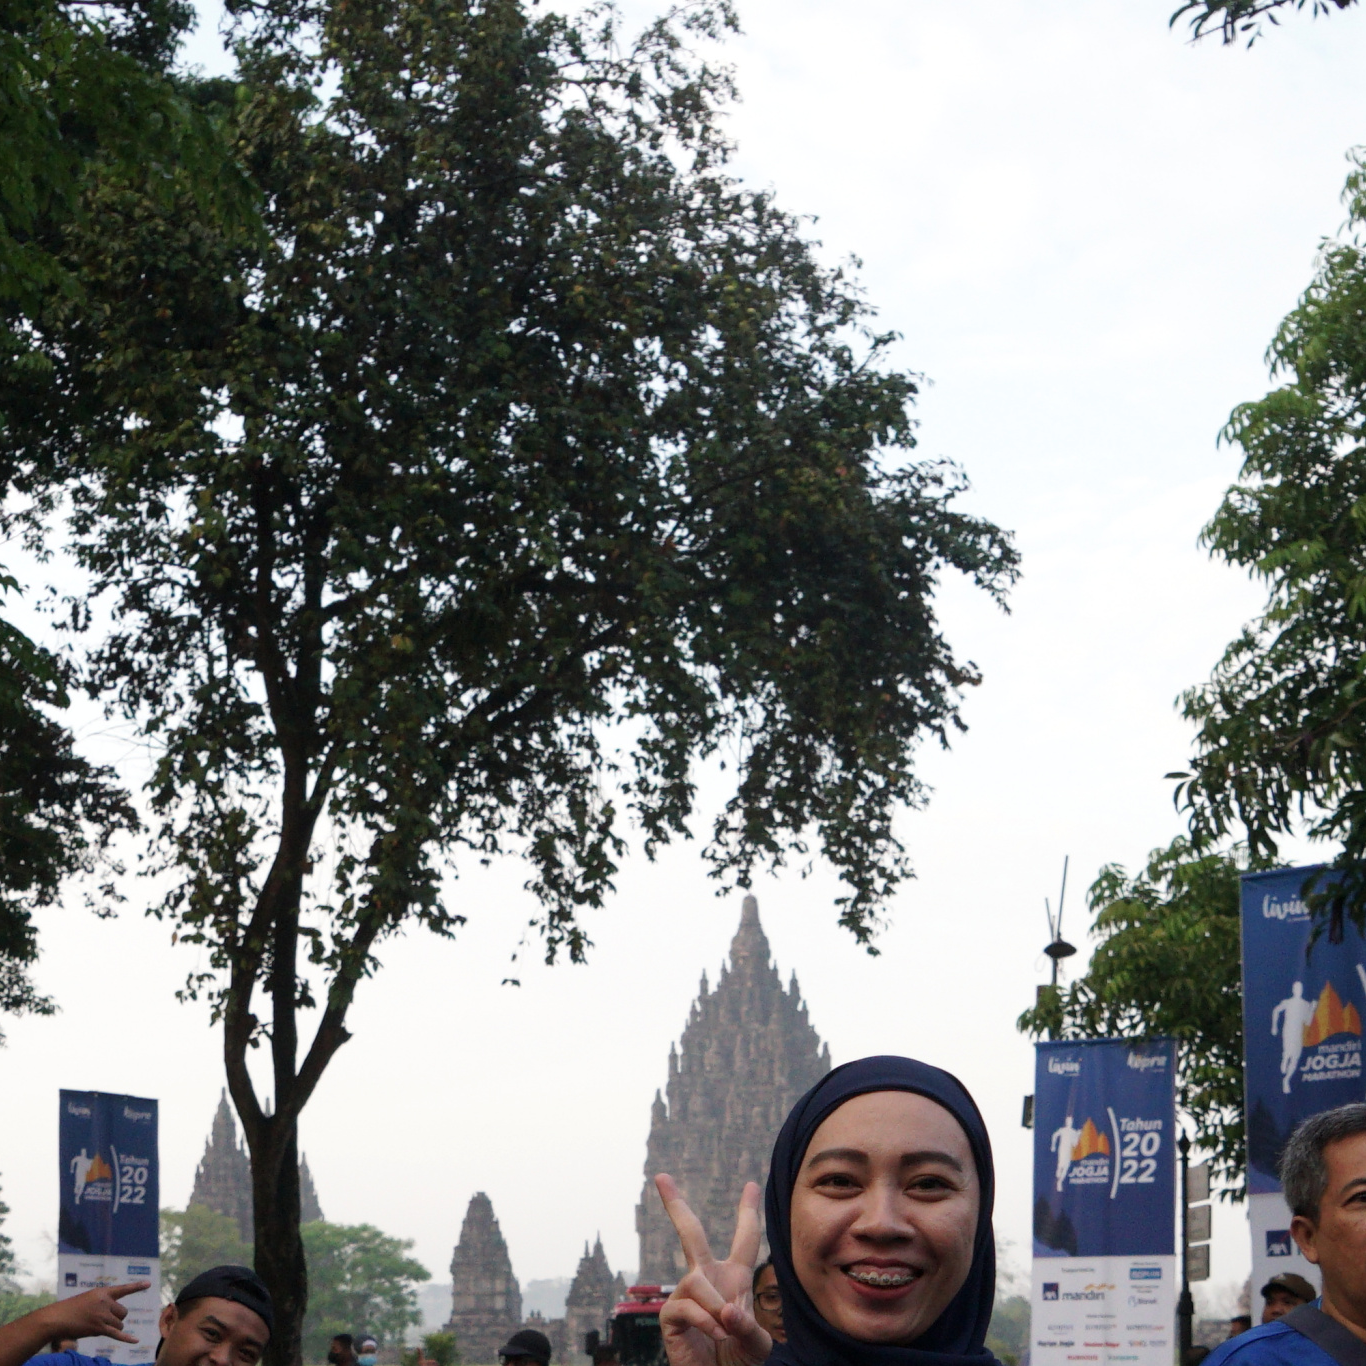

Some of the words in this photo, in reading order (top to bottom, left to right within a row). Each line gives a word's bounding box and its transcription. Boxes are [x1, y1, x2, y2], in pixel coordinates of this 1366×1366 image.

[1318, 1040, 1363, 1054] mandiri
[1300, 1052, 1362, 1072] JOGJA
[1119, 1117, 1163, 1132] Tahun
[1122, 1132, 1161, 1157] 20
[120, 1166, 149, 1185] 20
[1069, 1166, 1109, 1177] JOGJA
[1119, 1158, 1157, 1184] 22
[120, 1185, 146, 1204] 22
